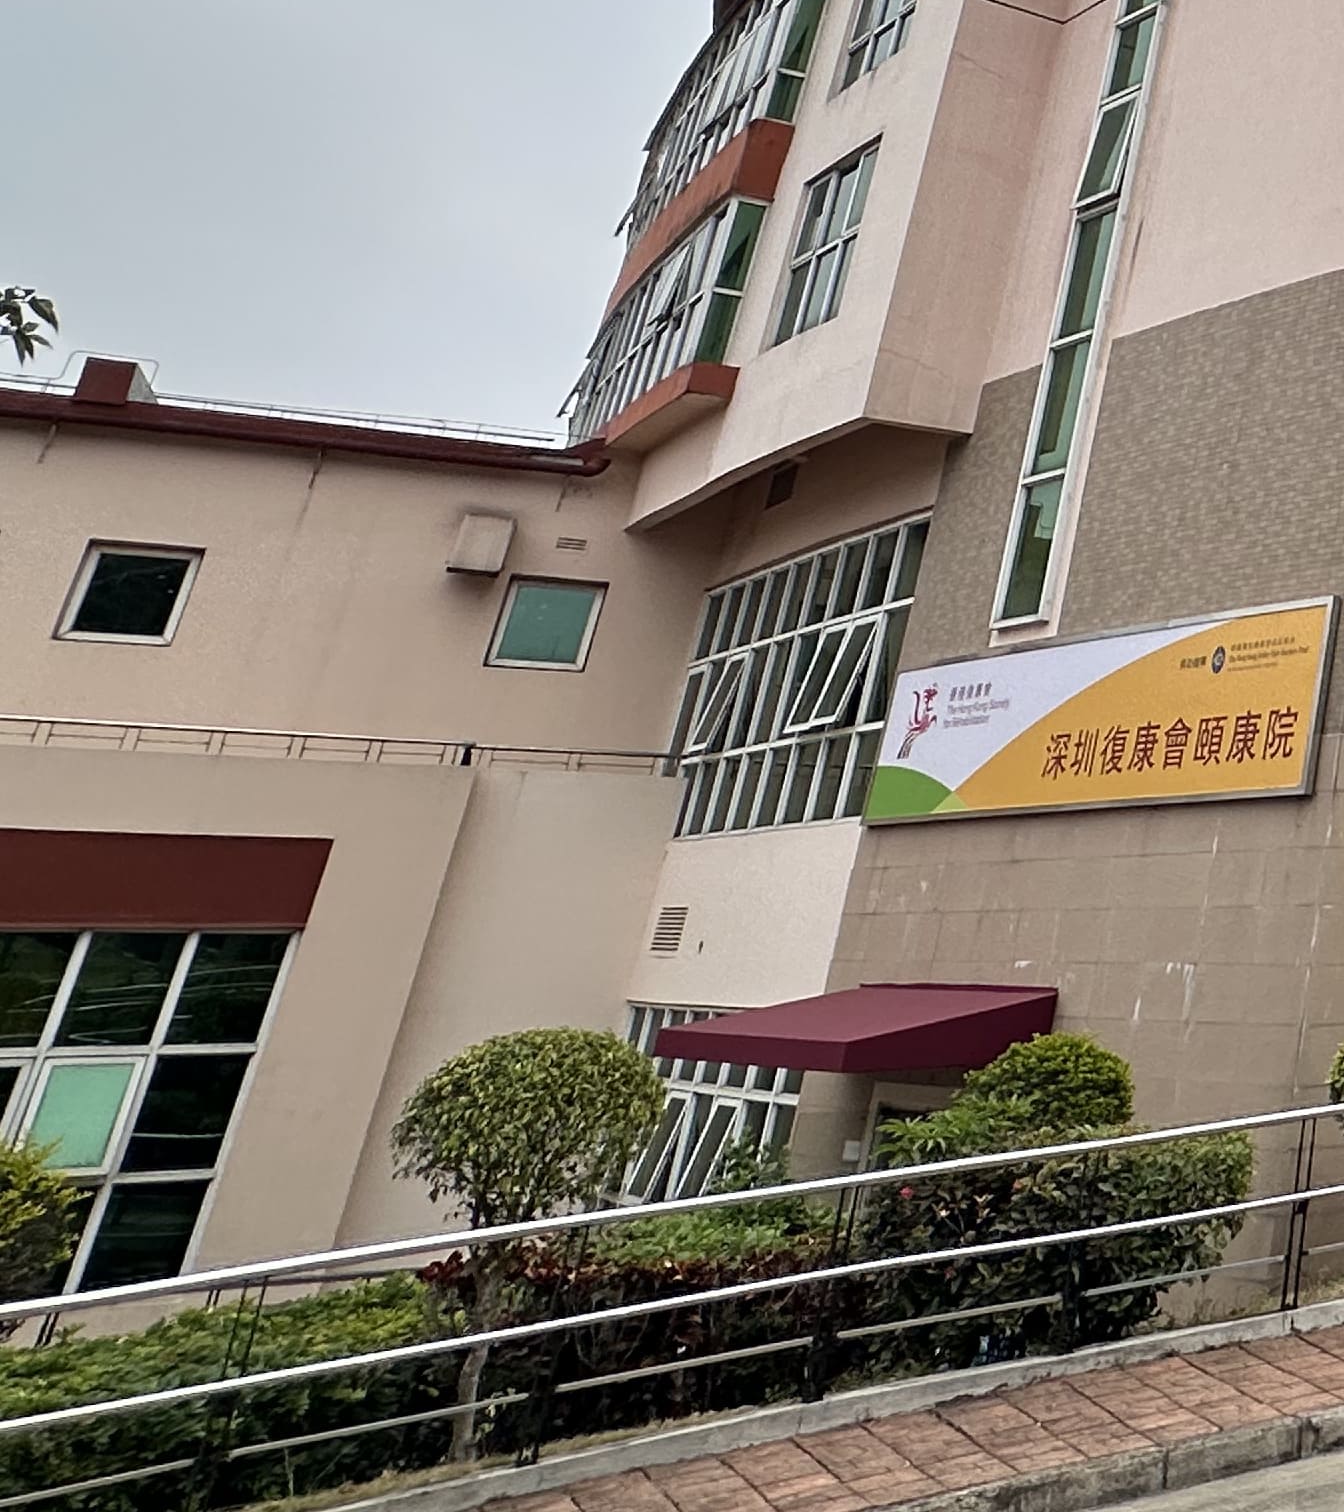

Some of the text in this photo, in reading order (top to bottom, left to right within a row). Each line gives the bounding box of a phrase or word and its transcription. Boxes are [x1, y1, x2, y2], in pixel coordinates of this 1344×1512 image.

[1041, 706, 1299, 780] 深圳復康會頤康院
